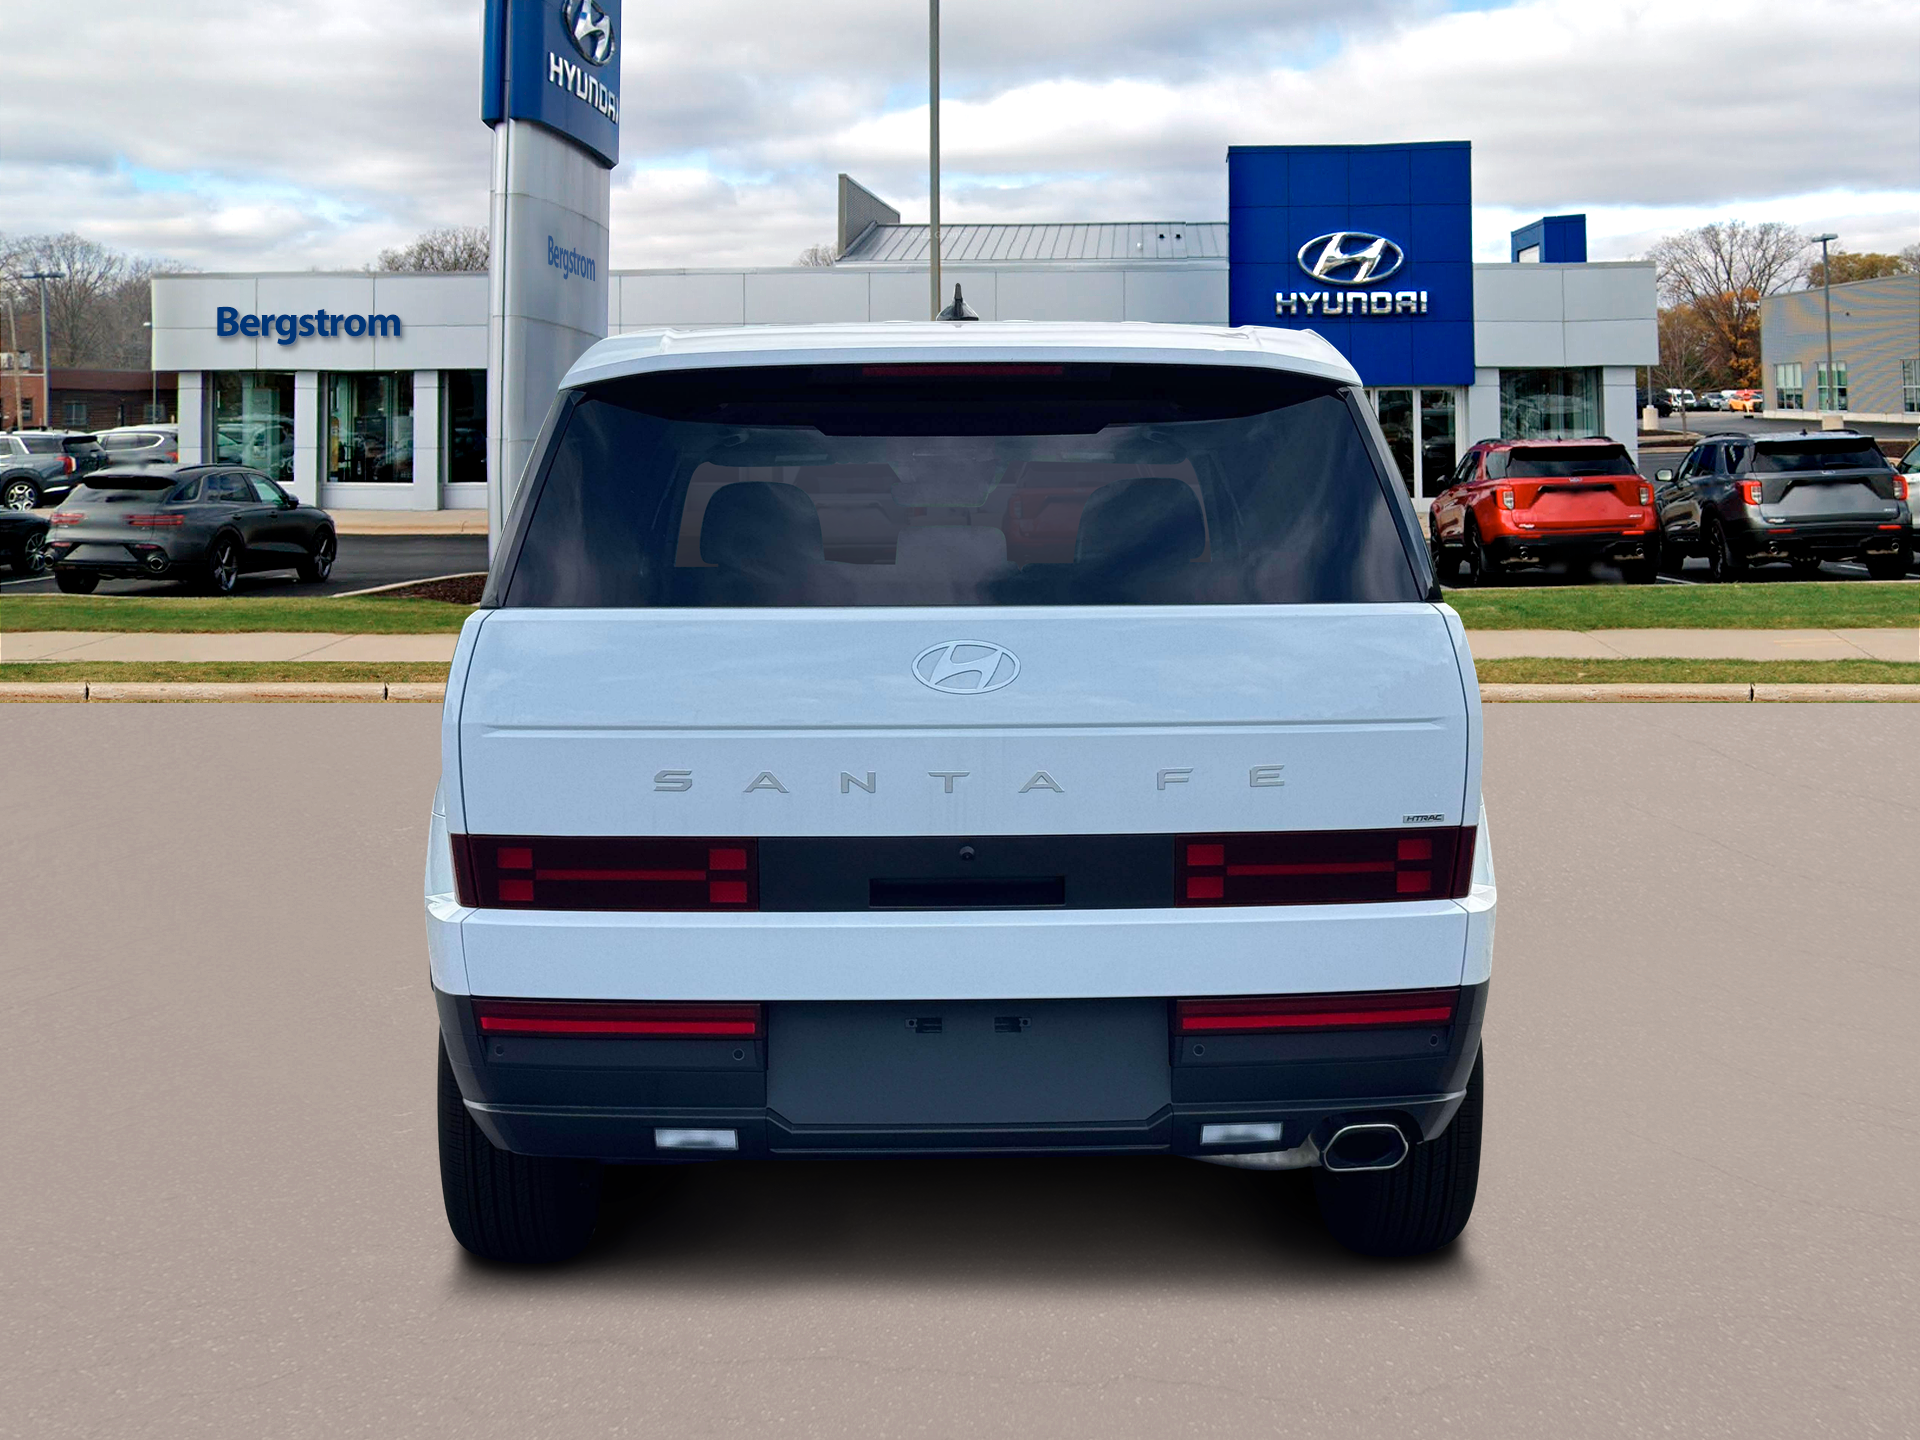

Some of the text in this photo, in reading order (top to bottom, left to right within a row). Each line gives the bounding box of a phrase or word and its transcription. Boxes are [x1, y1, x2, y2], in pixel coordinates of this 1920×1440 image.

[549, 51, 619, 124] HYUNDAI
[547, 235, 596, 282] Bergstrom
[1275, 290, 1428, 315] HYUNDAI
[216, 306, 401, 346] Bergstrom
[653, 764, 1285, 794] SANTA FE
[1406, 814, 1442, 822] HTRAC
